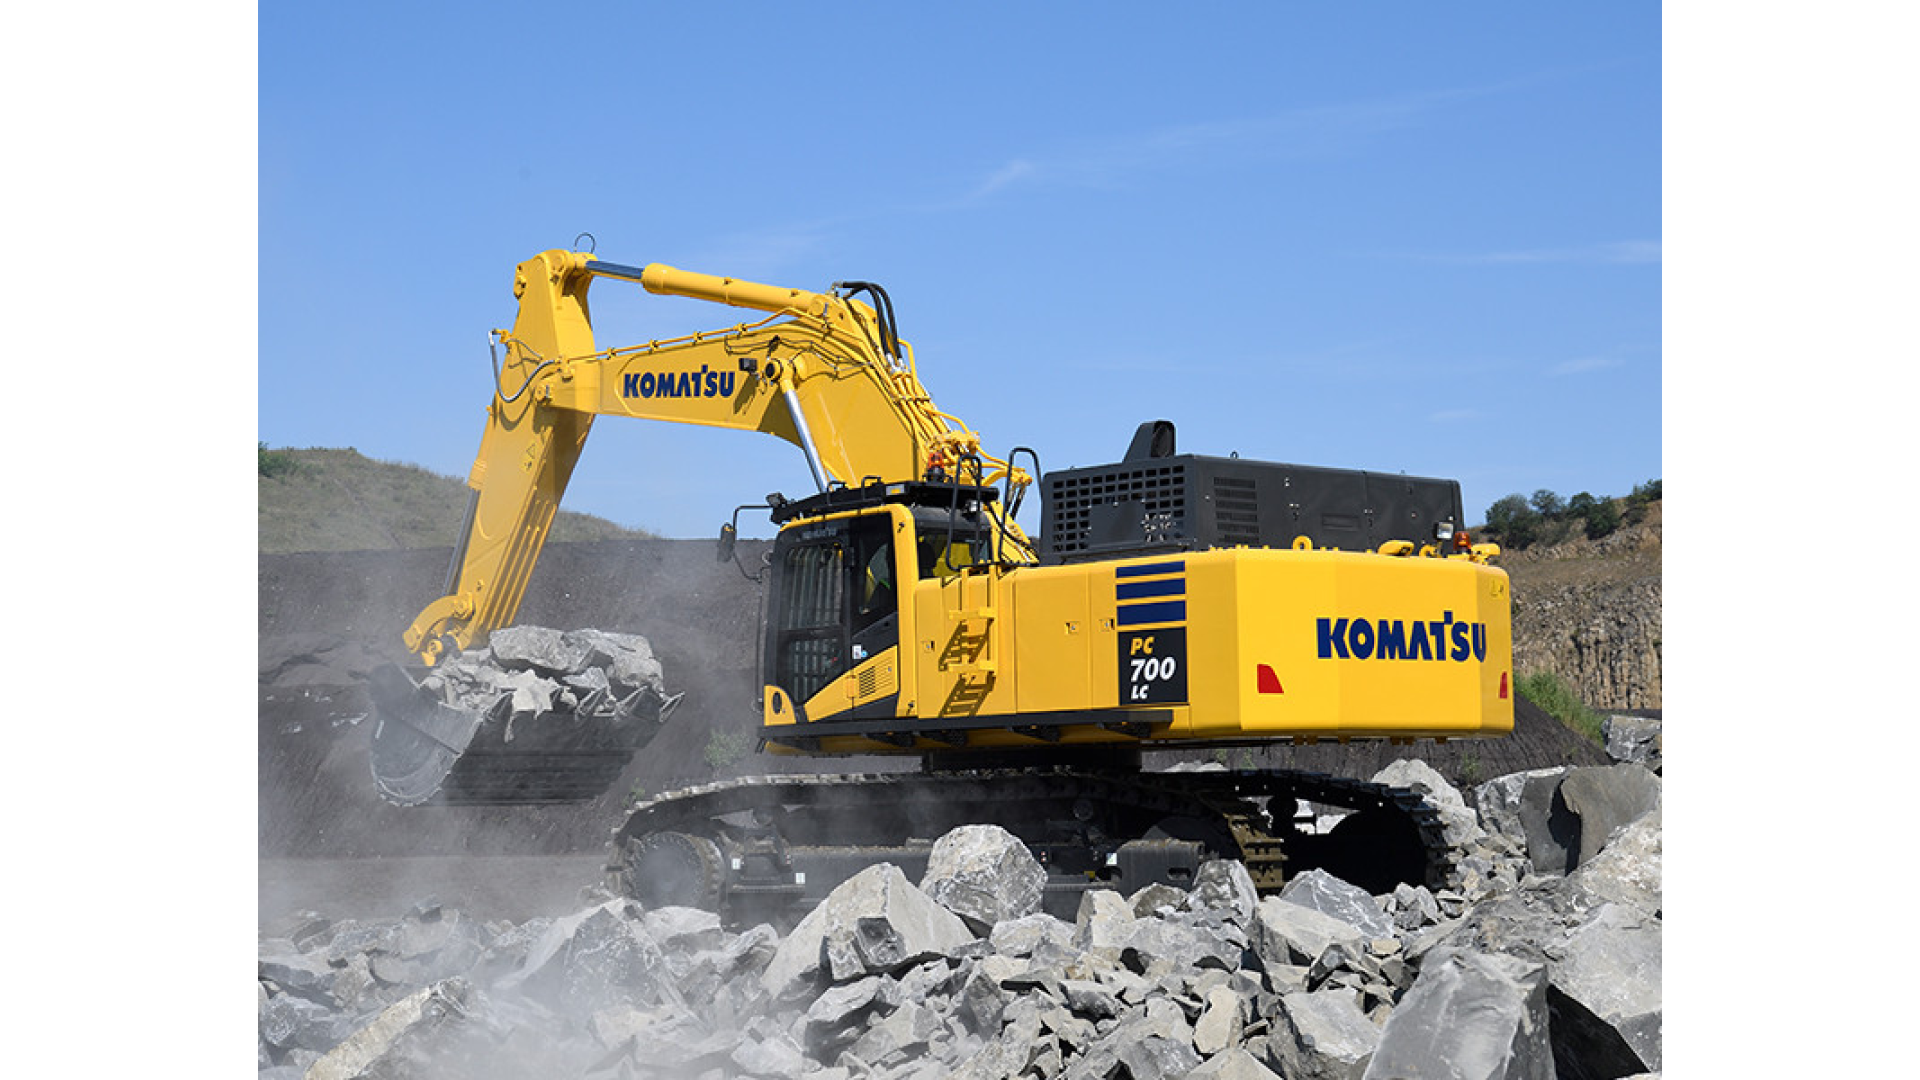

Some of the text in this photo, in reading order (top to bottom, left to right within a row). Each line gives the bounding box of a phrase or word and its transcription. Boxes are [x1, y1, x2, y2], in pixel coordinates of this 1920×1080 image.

[623, 364, 735, 398] KOMATSU
[1130, 636, 1155, 656] PC
[1316, 610, 1486, 662] KOMATSU
[1130, 656, 1177, 683] 700
[1130, 684, 1149, 700] LC
